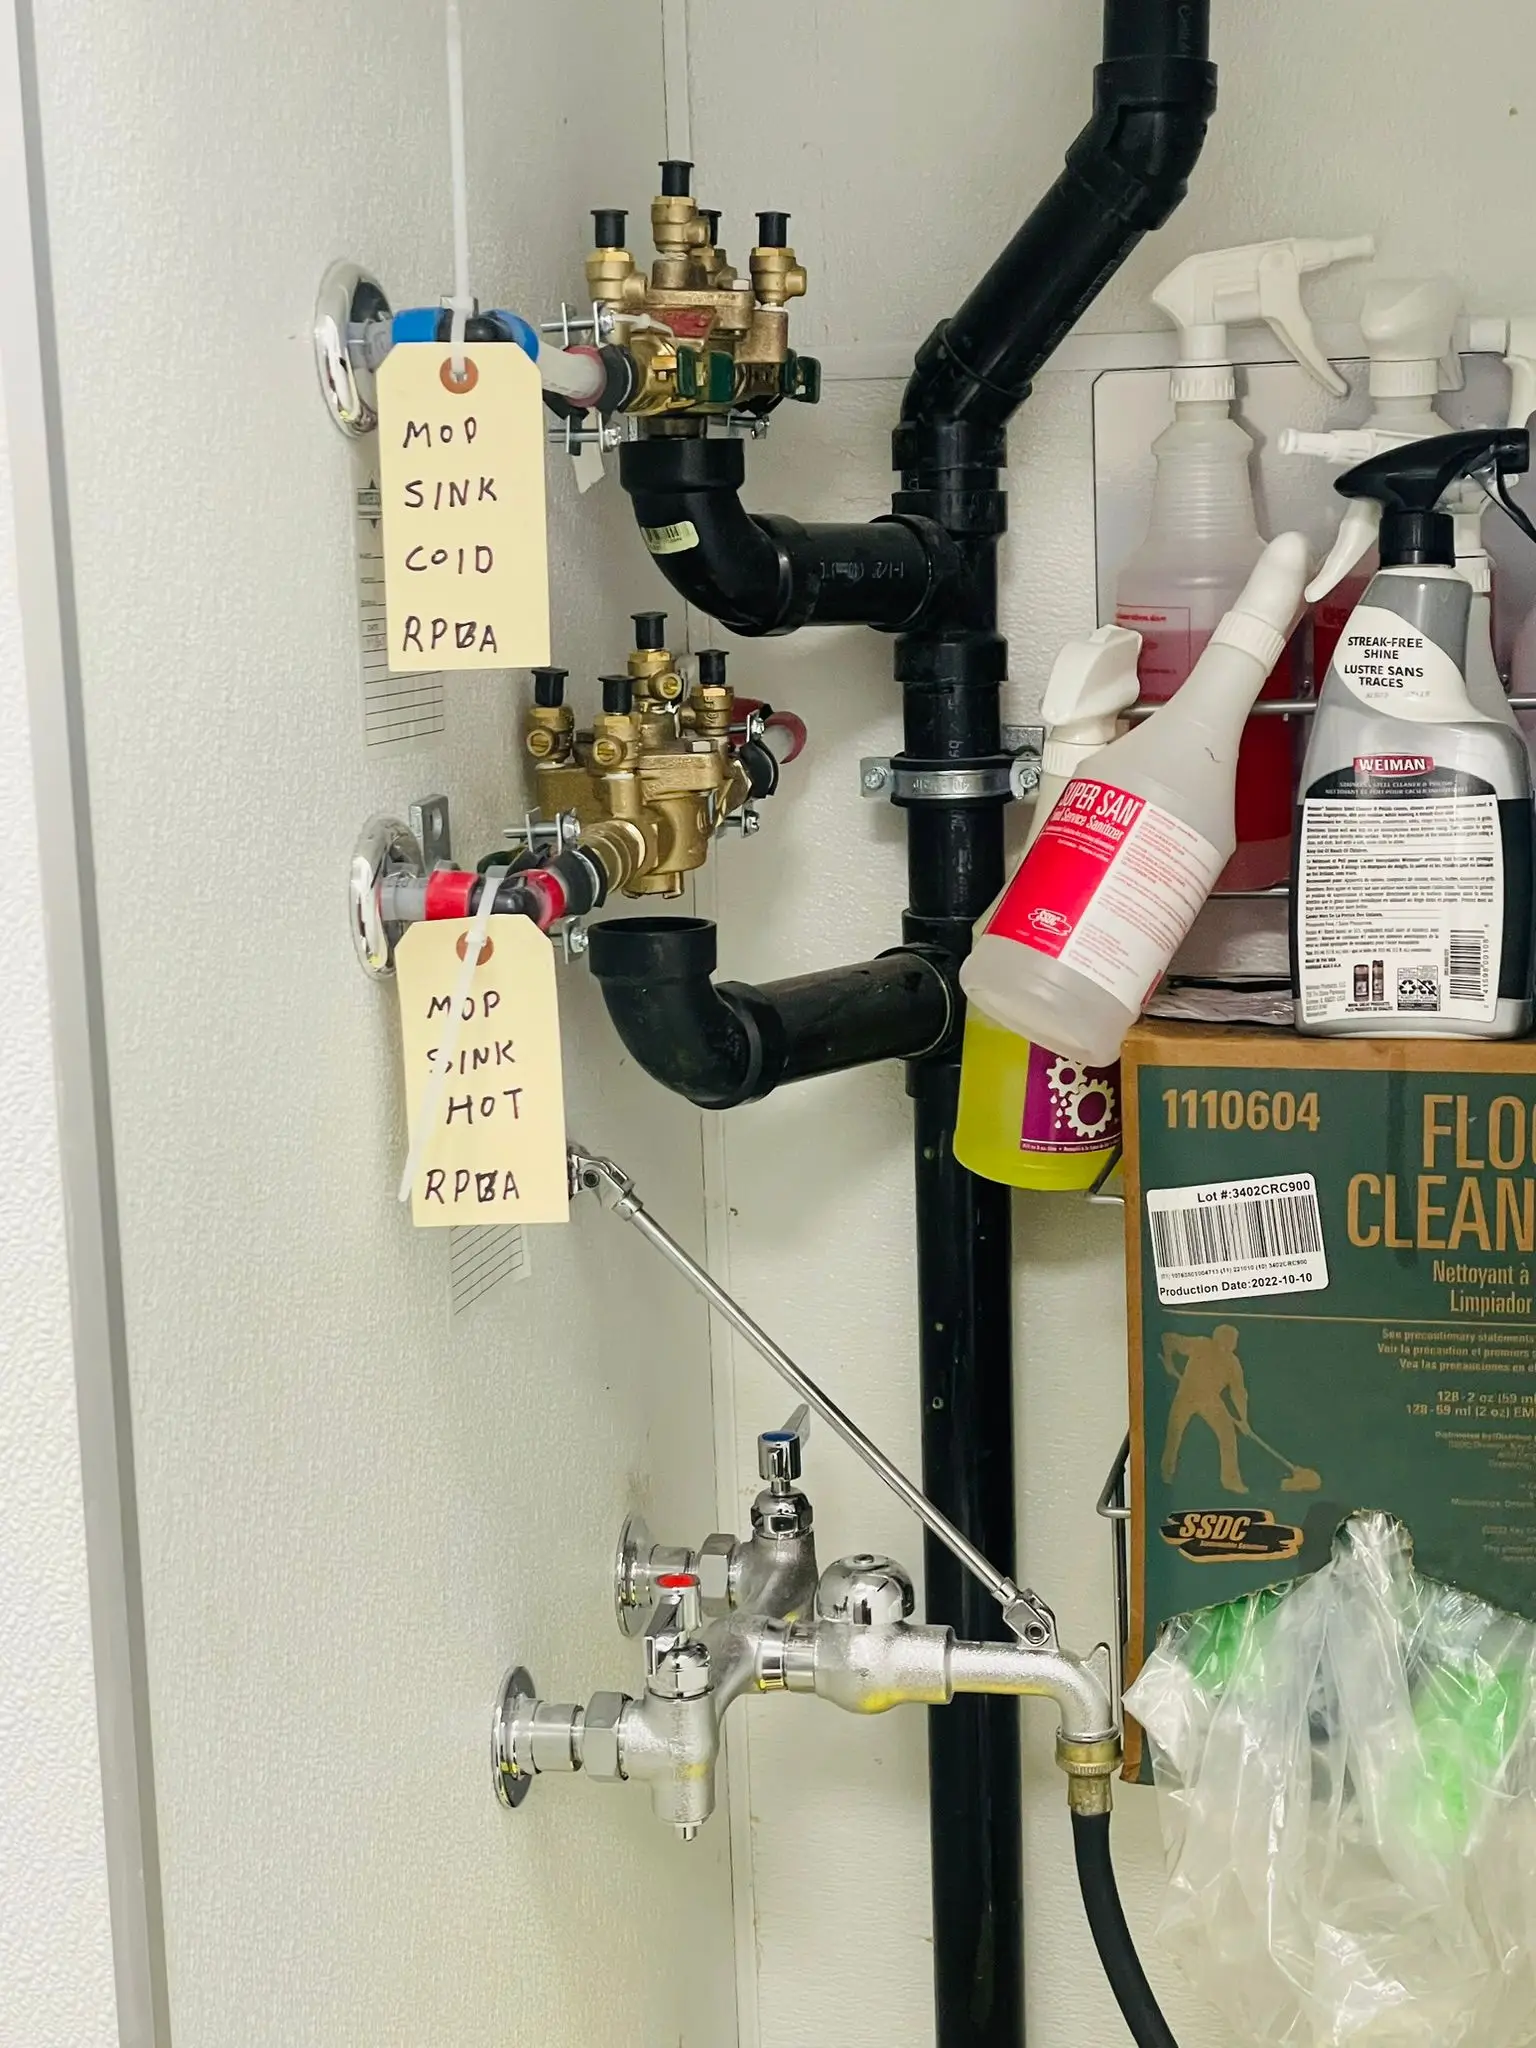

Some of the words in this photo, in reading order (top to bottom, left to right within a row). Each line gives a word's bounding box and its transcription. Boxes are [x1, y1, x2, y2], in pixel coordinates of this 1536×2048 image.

[402, 416, 477, 448] MOP
[404, 476, 498, 510] SINK
[1347, 636, 1423, 649] STREAK-FREE
[1363, 649, 1400, 660] SHINE
[1344, 664, 1384, 676] LUSTRE
[1387, 665, 1424, 677] SANS
[1358, 676, 1404, 689] TRACES
[1358, 758, 1427, 771] WEIMAN
[1095, 789, 1140, 827] SAN
[426, 990, 501, 1021] MOP
[446, 1087, 524, 1125] HOT
[1162, 1088, 1320, 1132] 1110604
[1423, 1094, 1536, 1171] FLO
[1197, 1191, 1218, 1203] Lot
[1347, 1173, 1535, 1253] CLEAN
[1433, 1259, 1514, 1289] Nettoyant
[1519, 1263, 1530, 1285] à
[1160, 1281, 1219, 1297] Production
[1451, 1289, 1532, 1317] Limpiador
[1382, 1328, 1402, 1339] See
[1404, 1330, 1476, 1343] precautionary
[1179, 1513, 1251, 1541] SSDC
